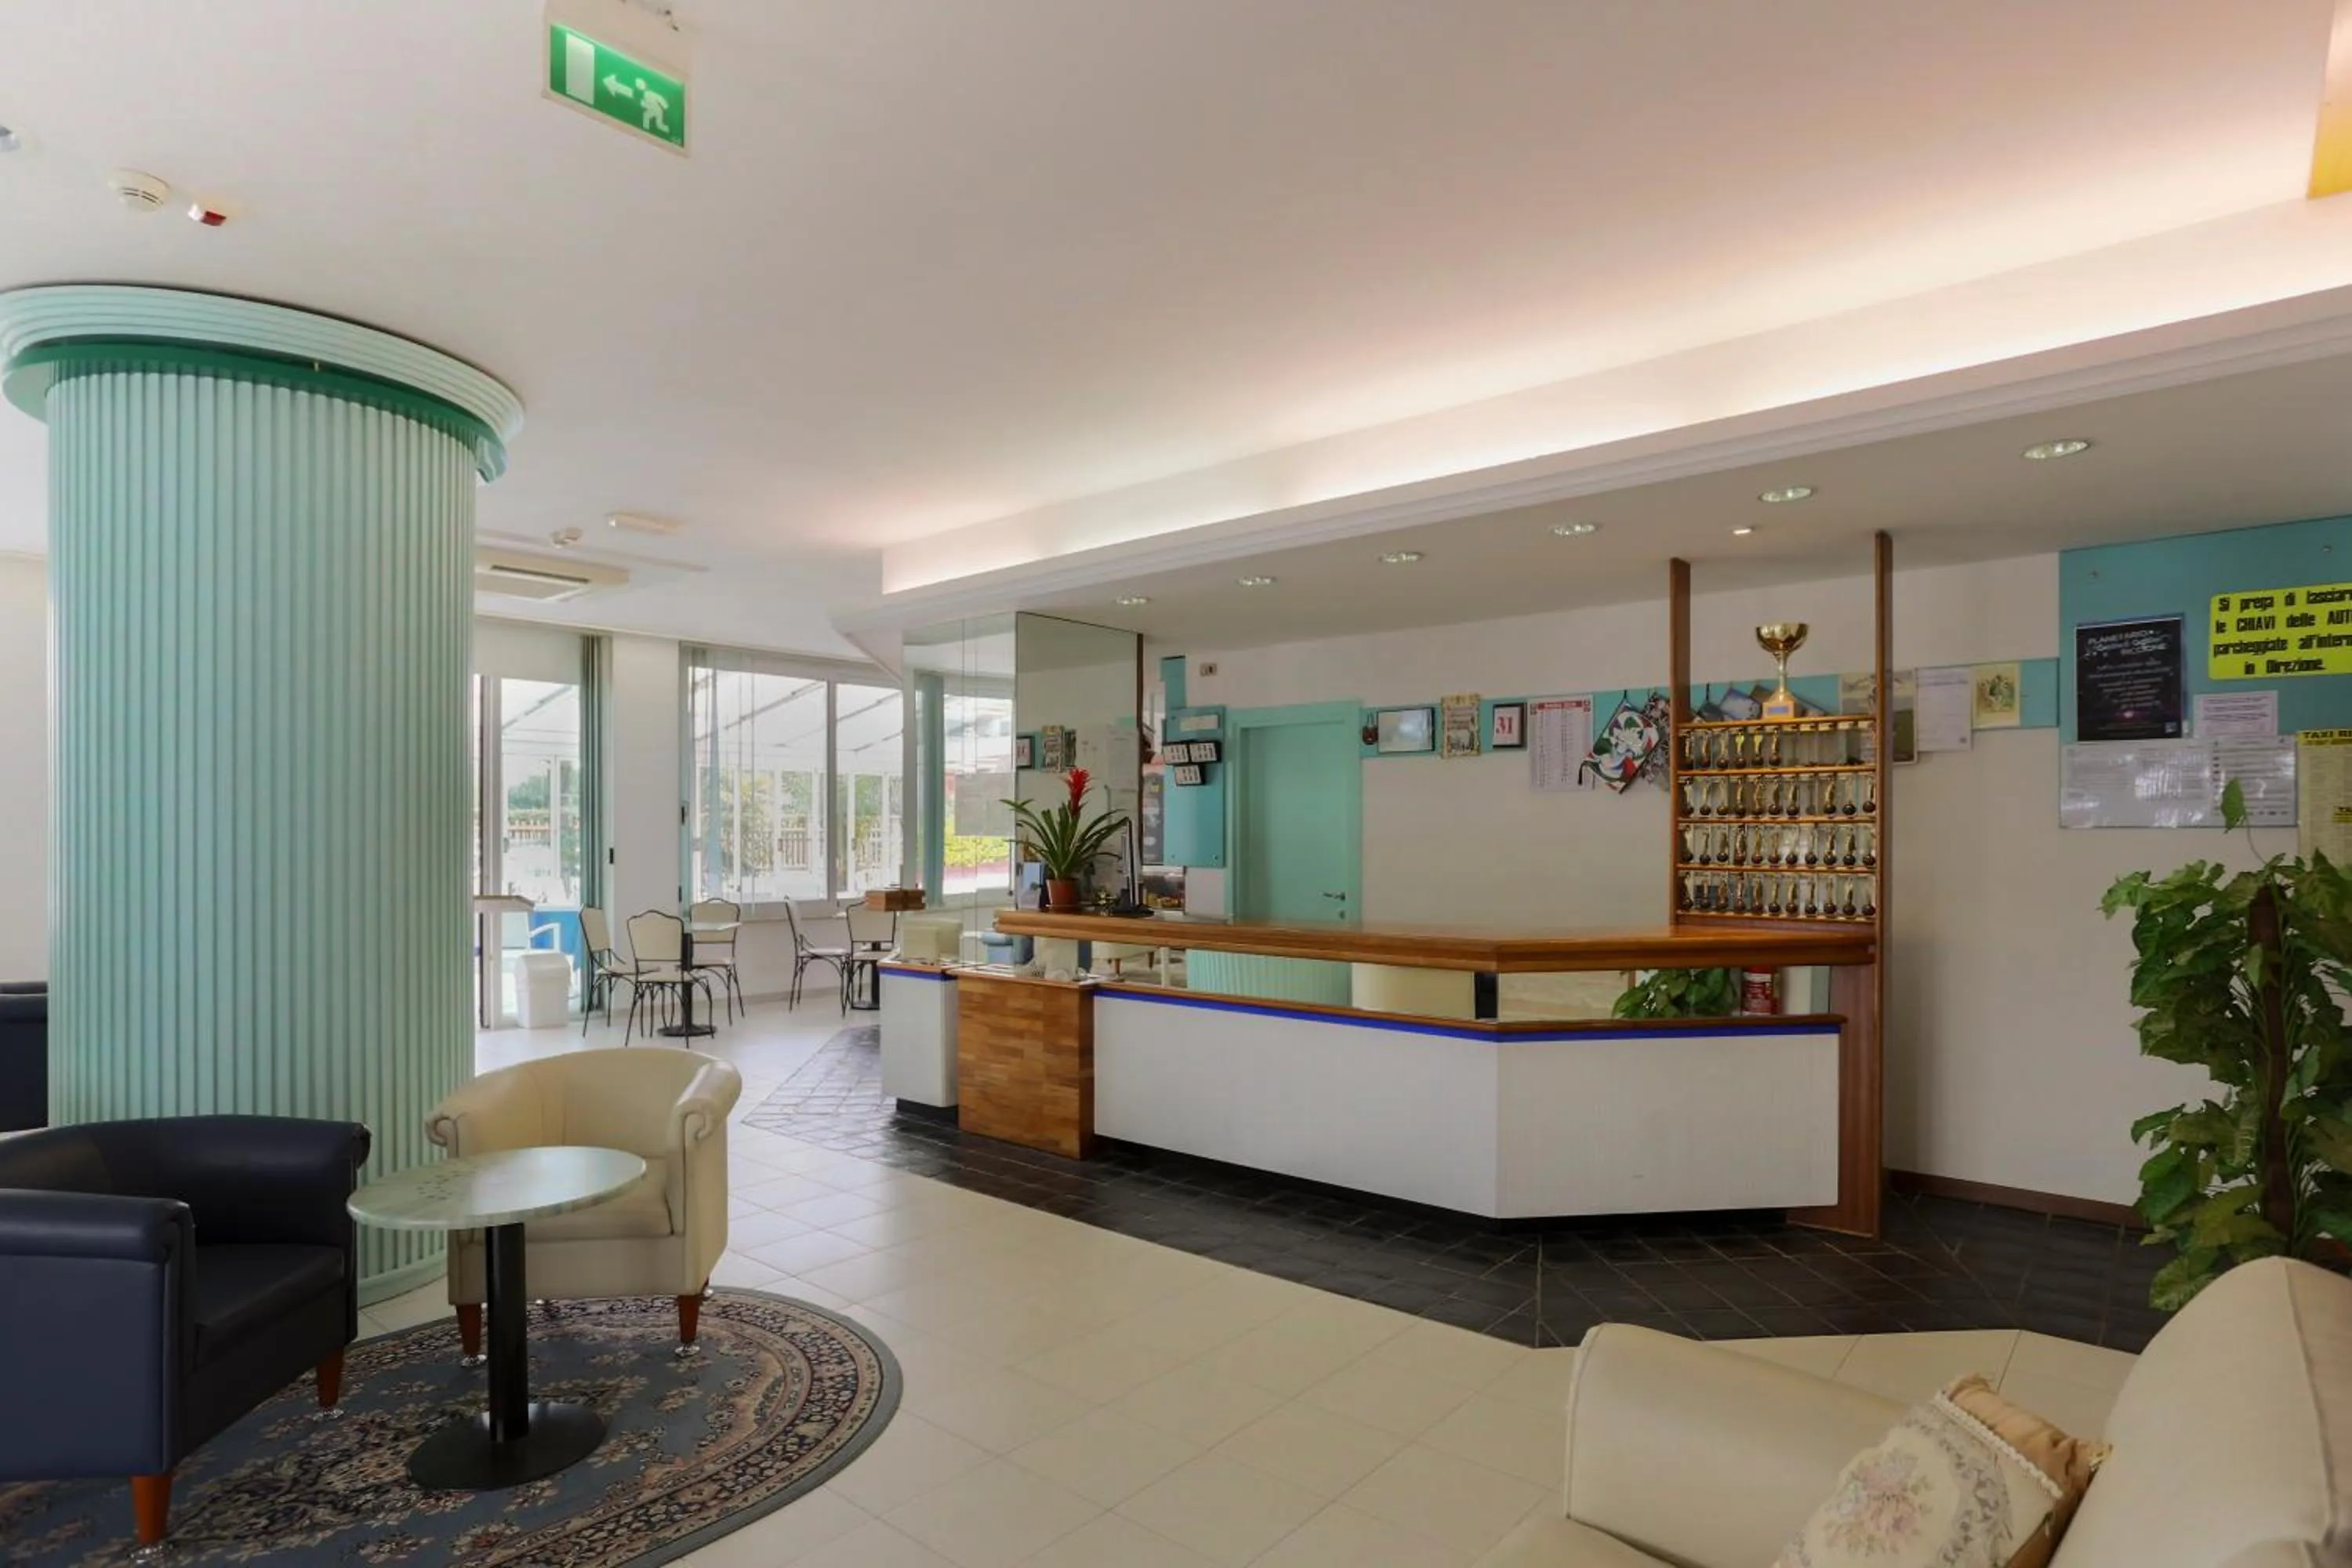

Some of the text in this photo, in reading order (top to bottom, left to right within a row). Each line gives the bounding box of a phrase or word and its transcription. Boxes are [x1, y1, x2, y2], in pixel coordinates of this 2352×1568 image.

[2219, 588, 2352, 612] Si prega di lasciar
[2216, 609, 2352, 633] le CHIAVI delle AUT
[2213, 633, 2352, 658] parcheggiate all'intern
[2245, 659, 2326, 674] in Direzione.
[1495, 716, 1513, 734] 31
[2302, 731, 2333, 739] TAXI
